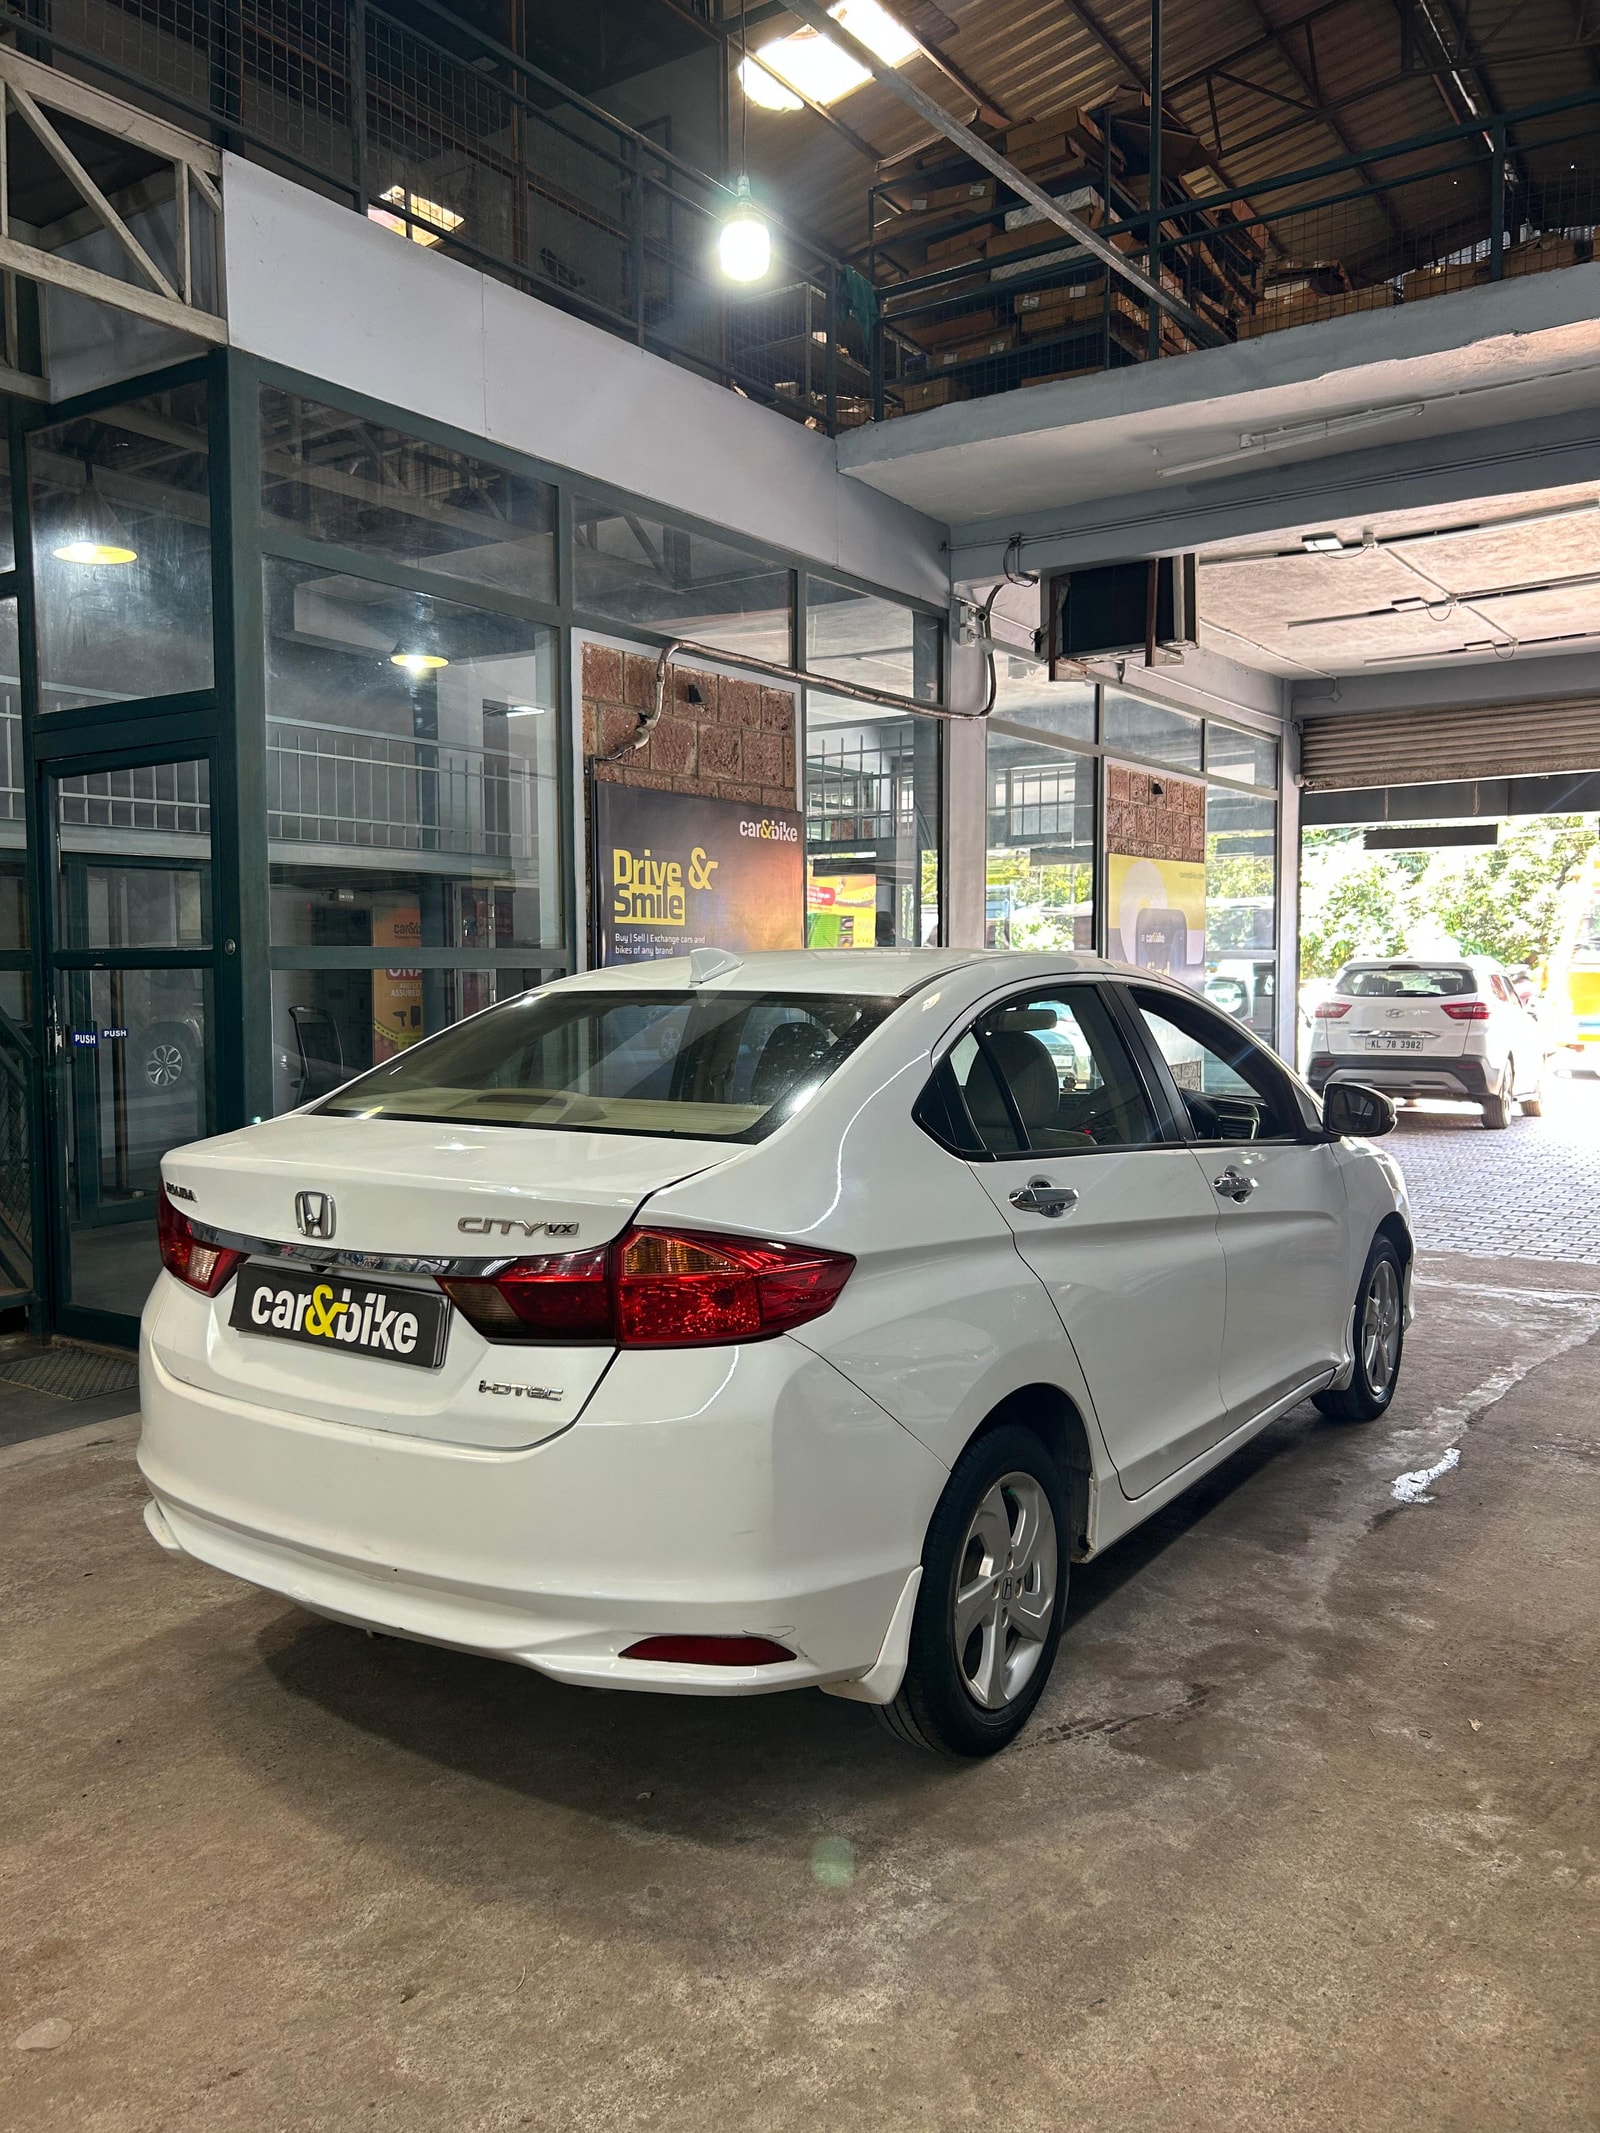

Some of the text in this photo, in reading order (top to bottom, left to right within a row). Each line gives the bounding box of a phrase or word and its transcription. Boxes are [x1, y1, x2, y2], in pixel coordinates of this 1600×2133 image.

[739, 819, 798, 842] car&bike
[613, 847, 719, 890] Drive &
[613, 883, 684, 920] Smile
[615, 933, 629, 943] Buy
[633, 933, 646, 942] Sell
[650, 934, 680, 945] Exchange
[615, 945, 674, 956] bikes of any brand
[390, 989, 421, 997] ASSURED
[74, 1034, 96, 1044] PUSH
[1370, 1039, 1381, 1049] KL
[457, 1217, 579, 1237] CITY VX
[251, 1284, 419, 1354] car&bike
[478, 1380, 564, 1402] i-DTEC
